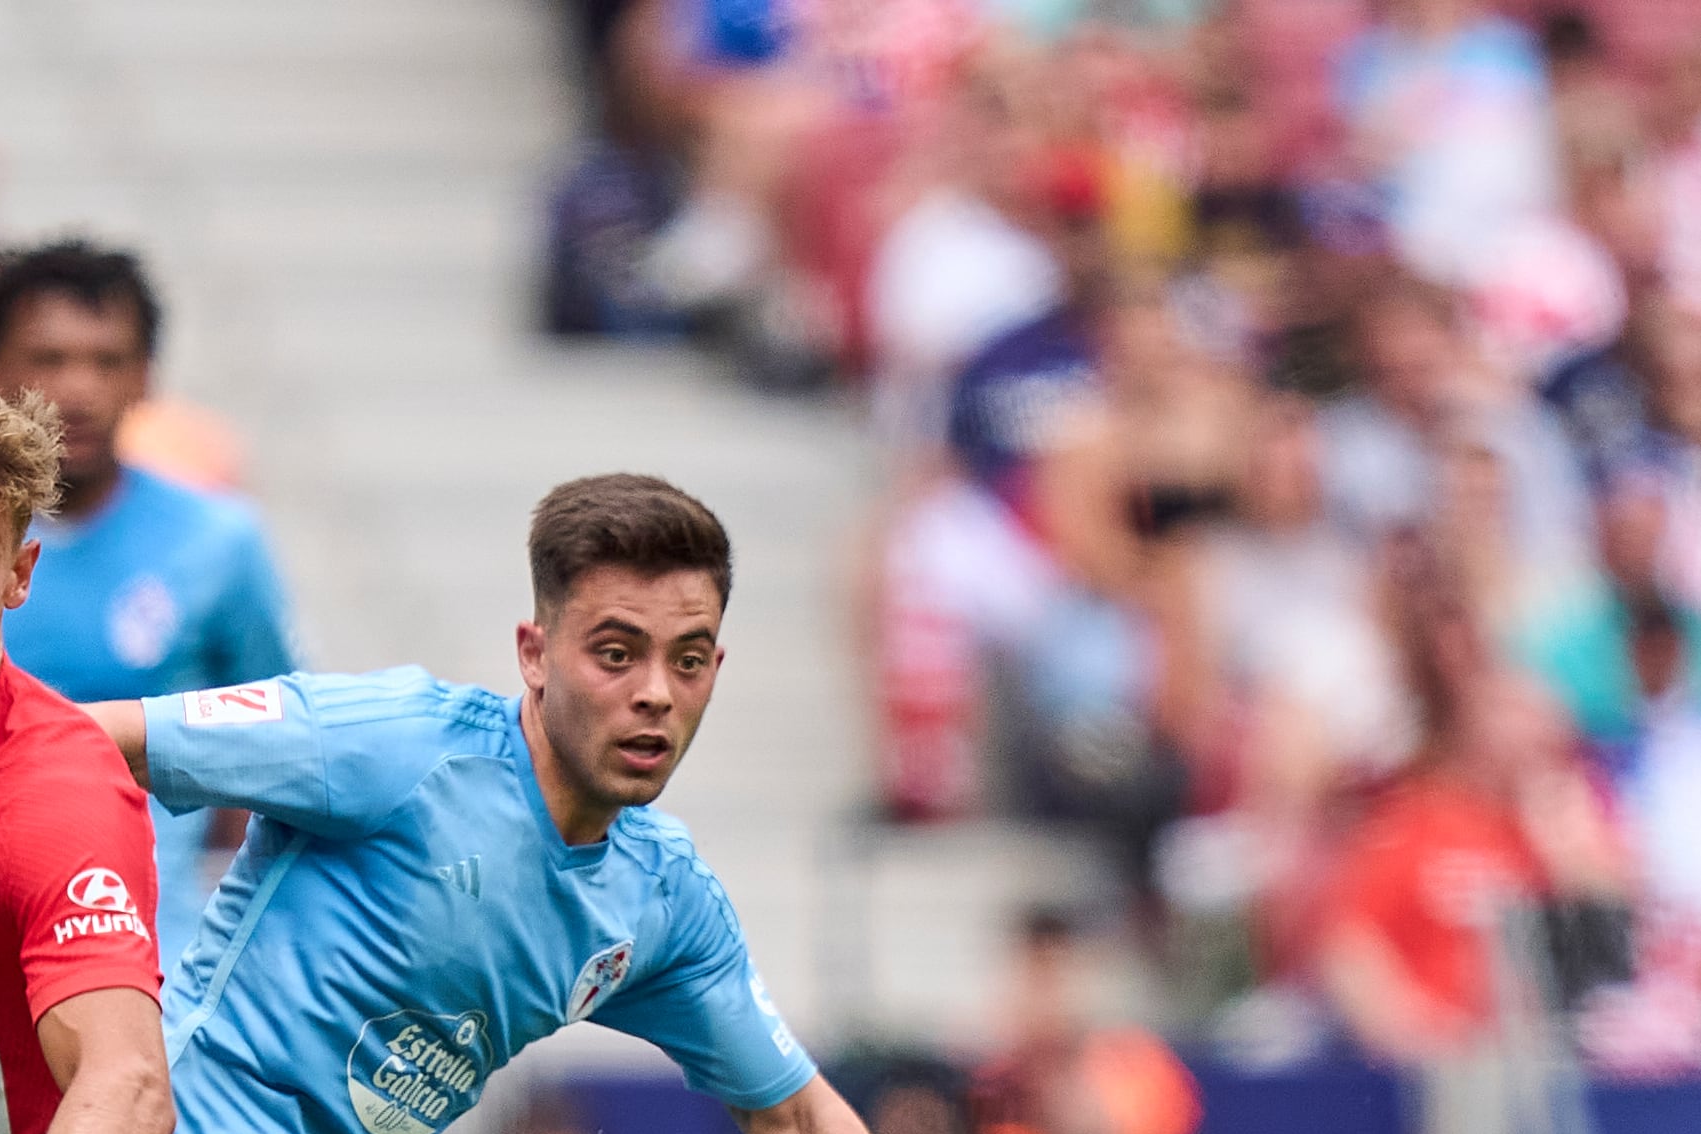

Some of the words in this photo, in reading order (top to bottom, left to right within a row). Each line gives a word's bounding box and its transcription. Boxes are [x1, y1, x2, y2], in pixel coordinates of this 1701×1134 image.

[54, 913, 152, 945] HYUND
[373, 1055, 449, 1120] Galicia
[386, 1024, 476, 1093] Estrella
